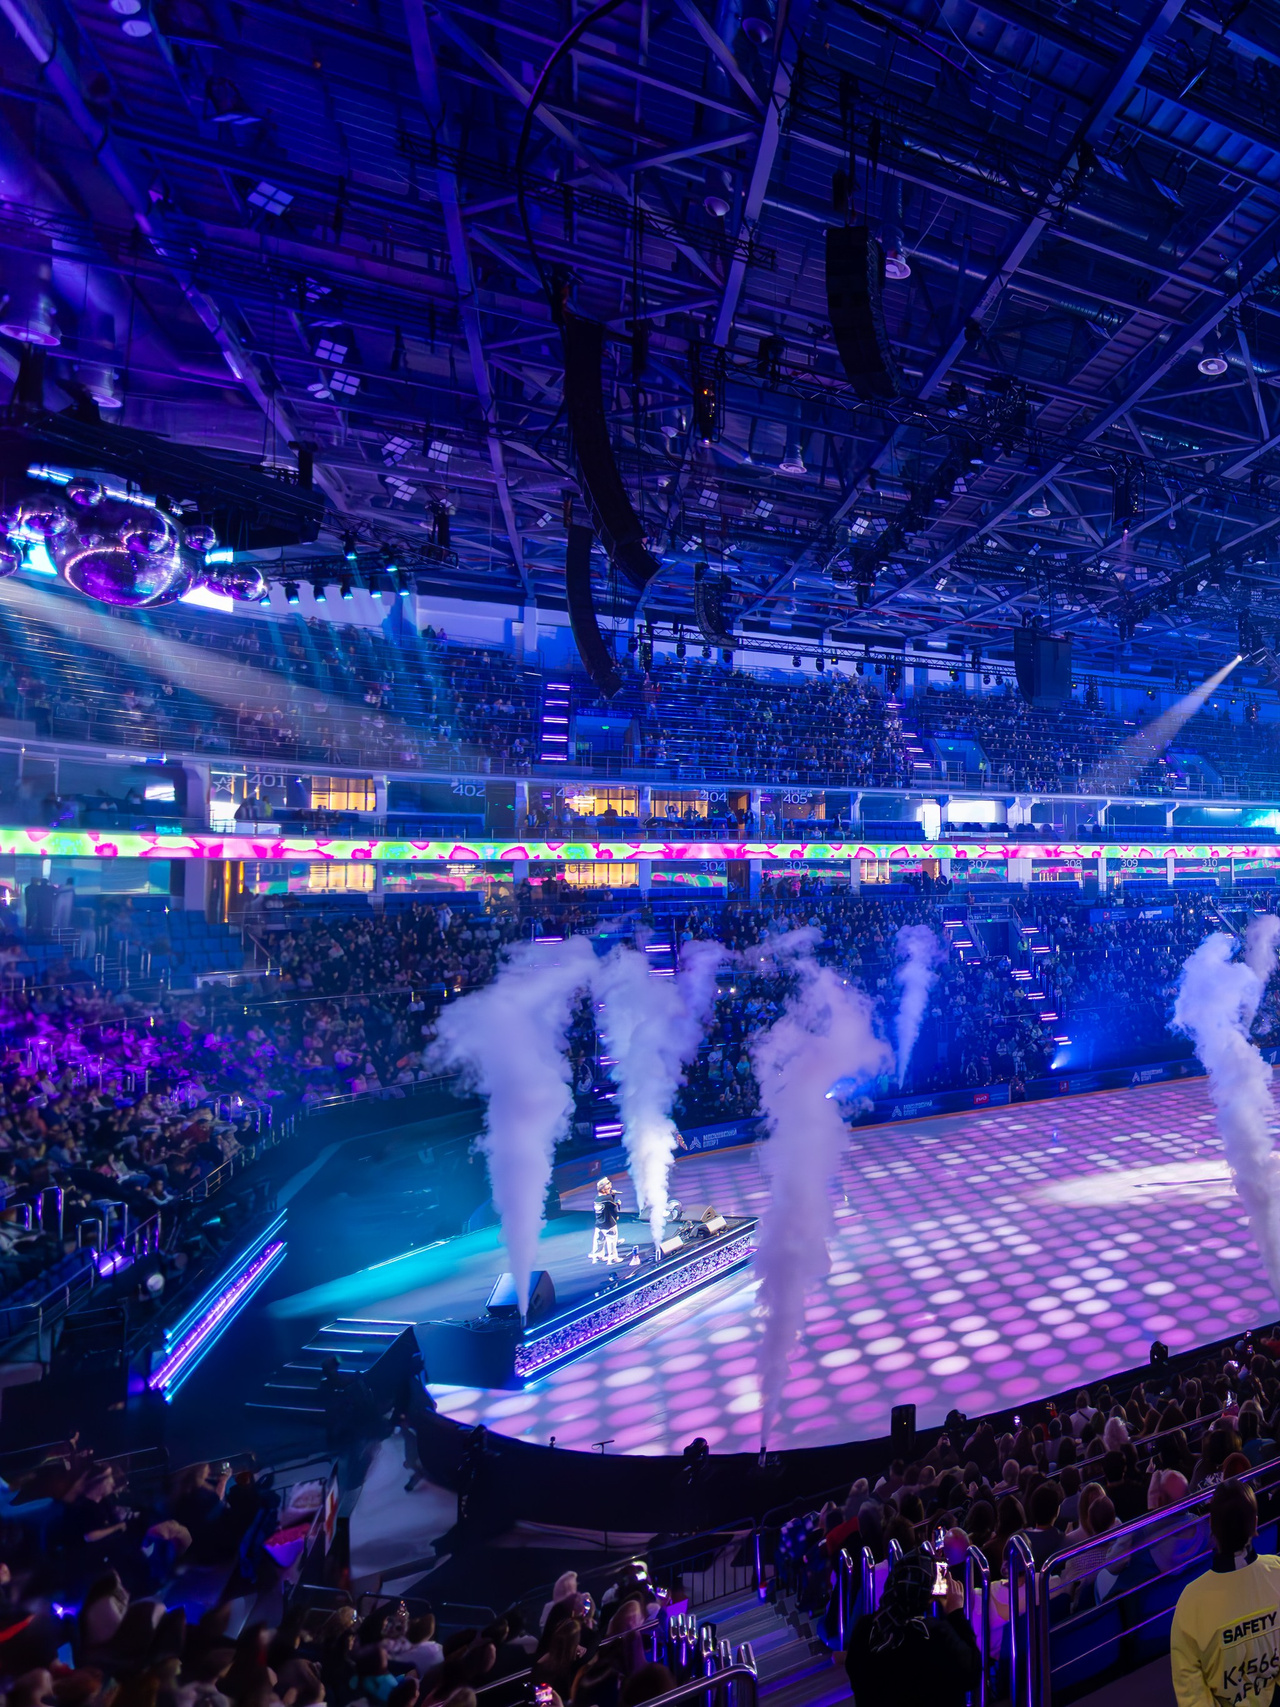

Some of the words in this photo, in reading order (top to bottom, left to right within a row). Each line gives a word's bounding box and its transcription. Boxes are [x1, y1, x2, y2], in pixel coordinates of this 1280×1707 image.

[248, 773, 287, 788] 401
[452, 784, 485, 797] 402
[700, 791, 728, 803] 404
[783, 794, 808, 804] 405
[700, 861, 727, 872] 304
[785, 861, 810, 871] 305
[969, 860, 989, 869] 307
[1063, 859, 1082, 868] 308
[1121, 859, 1139, 868] 309
[1202, 859, 1218, 868] 310
[1222, 1611, 1278, 1644] SAFETY
